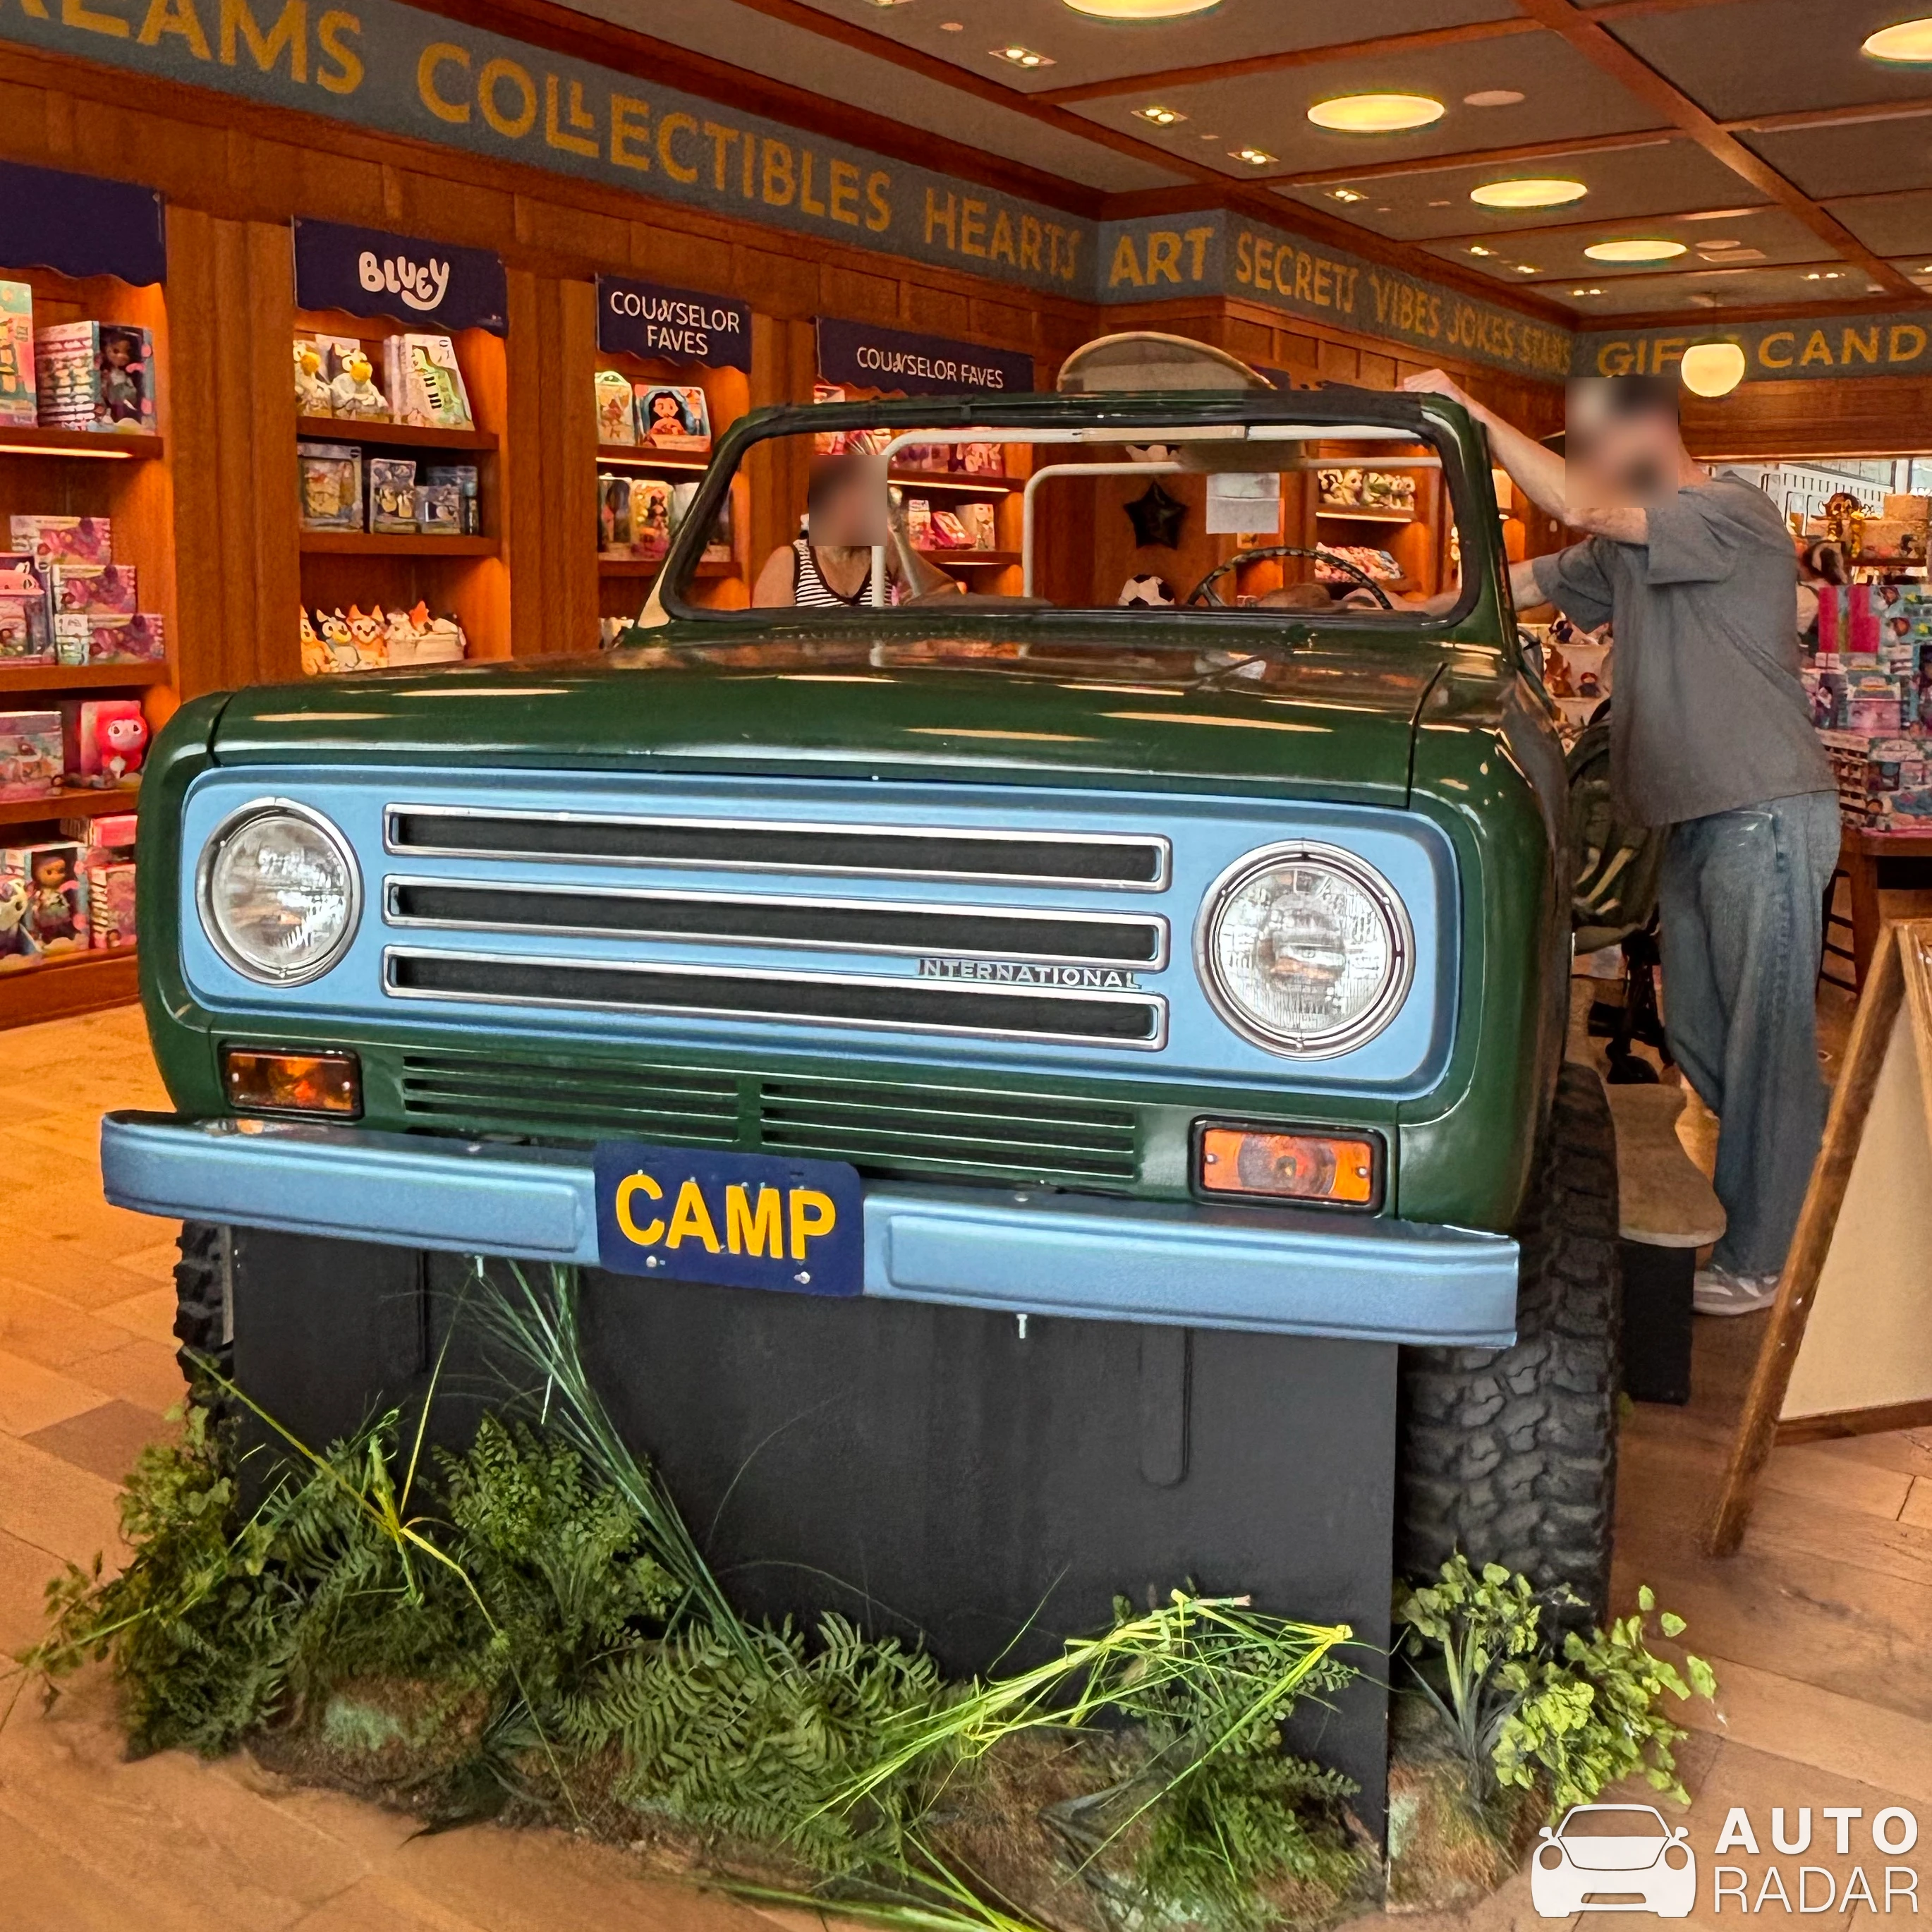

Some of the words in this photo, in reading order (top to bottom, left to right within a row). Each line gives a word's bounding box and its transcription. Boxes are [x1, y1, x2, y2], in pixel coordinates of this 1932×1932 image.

[418, 42, 892, 231] COLLECTIBLES
[925, 188, 1081, 280] HEARTS
[359, 252, 449, 310] BLUEY
[1108, 226, 1214, 287] ART
[611, 291, 739, 334] COUNSELOR
[1236, 231, 1360, 313] SECRETS
[1369, 272, 1441, 339] VIBES
[1447, 303, 1514, 359] JOKES
[648, 325, 708, 355] FAVES
[857, 347, 956, 382] COUNSELOR
[961, 365, 1004, 389] FAVES
[918, 958, 1141, 989] INTERNATIONAL
[616, 1174, 836, 1260] CAMP
